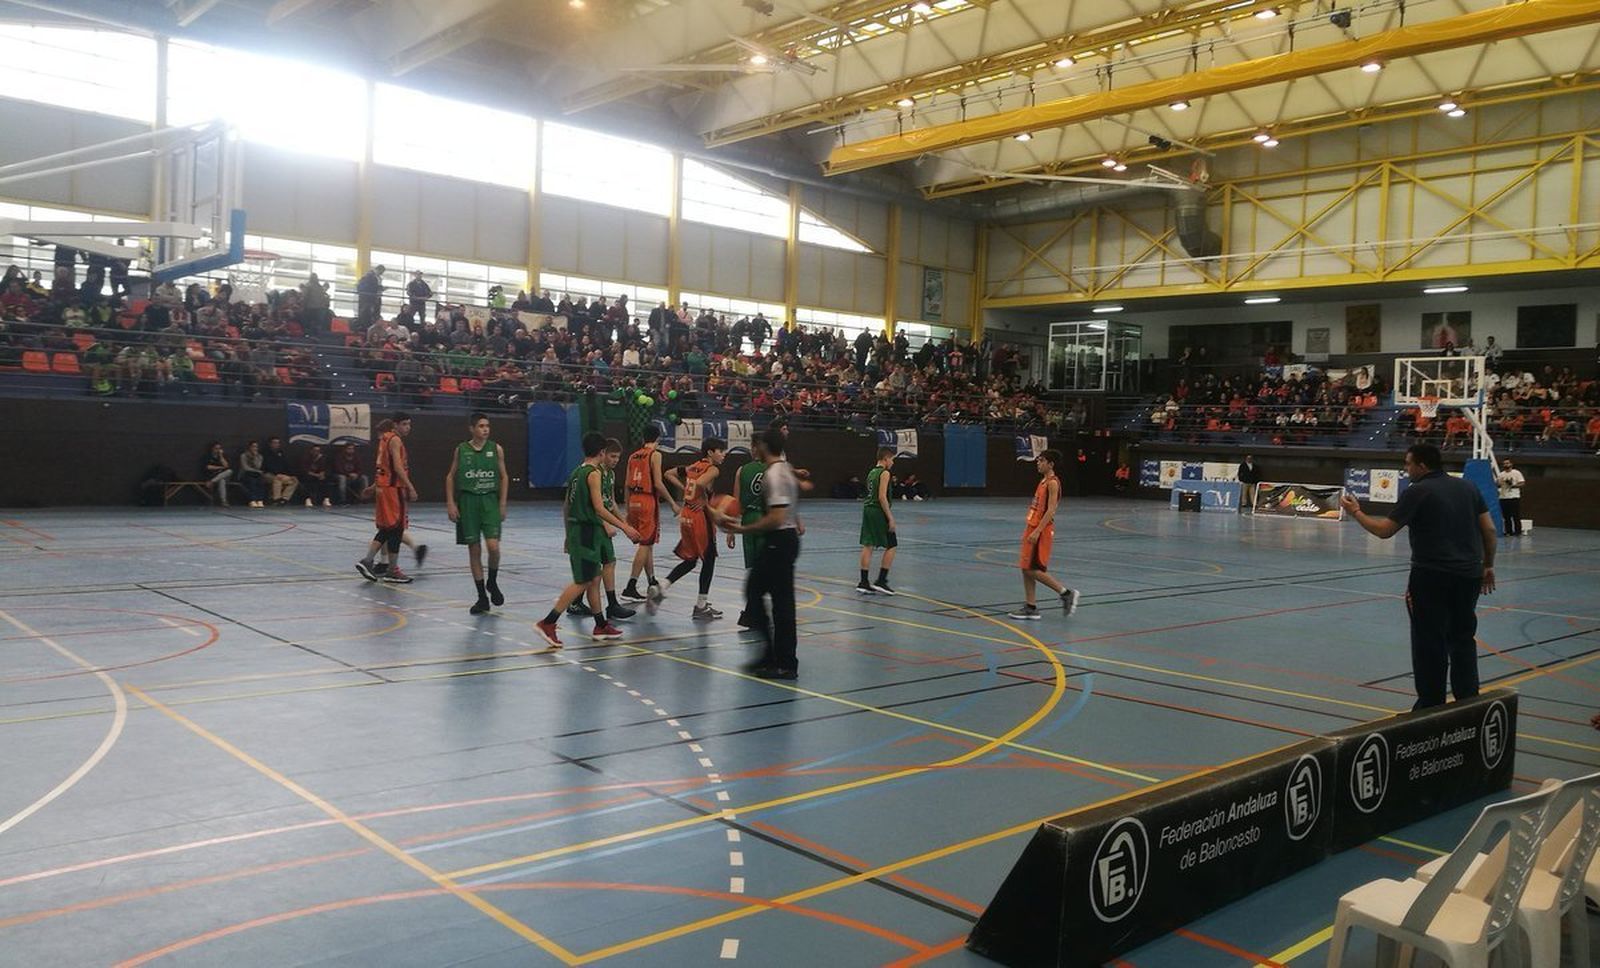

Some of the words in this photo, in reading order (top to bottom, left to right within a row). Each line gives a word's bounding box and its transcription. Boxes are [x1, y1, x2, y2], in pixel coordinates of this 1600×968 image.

[465, 469, 495, 479] divina
[633, 466, 643, 481] 4
[750, 472, 764, 496] 6
[1212, 490, 1231, 507] M
[1394, 735, 1440, 761] Federación
[1439, 726, 1477, 749] Andaluza
[1409, 763, 1422, 780] de
[1421, 752, 1465, 778] Baloncesto
[1158, 809, 1226, 849] Federación
[1226, 790, 1279, 824] Andaluza
[1179, 848, 1198, 871] de
[1198, 825, 1261, 864] Baloncesto
